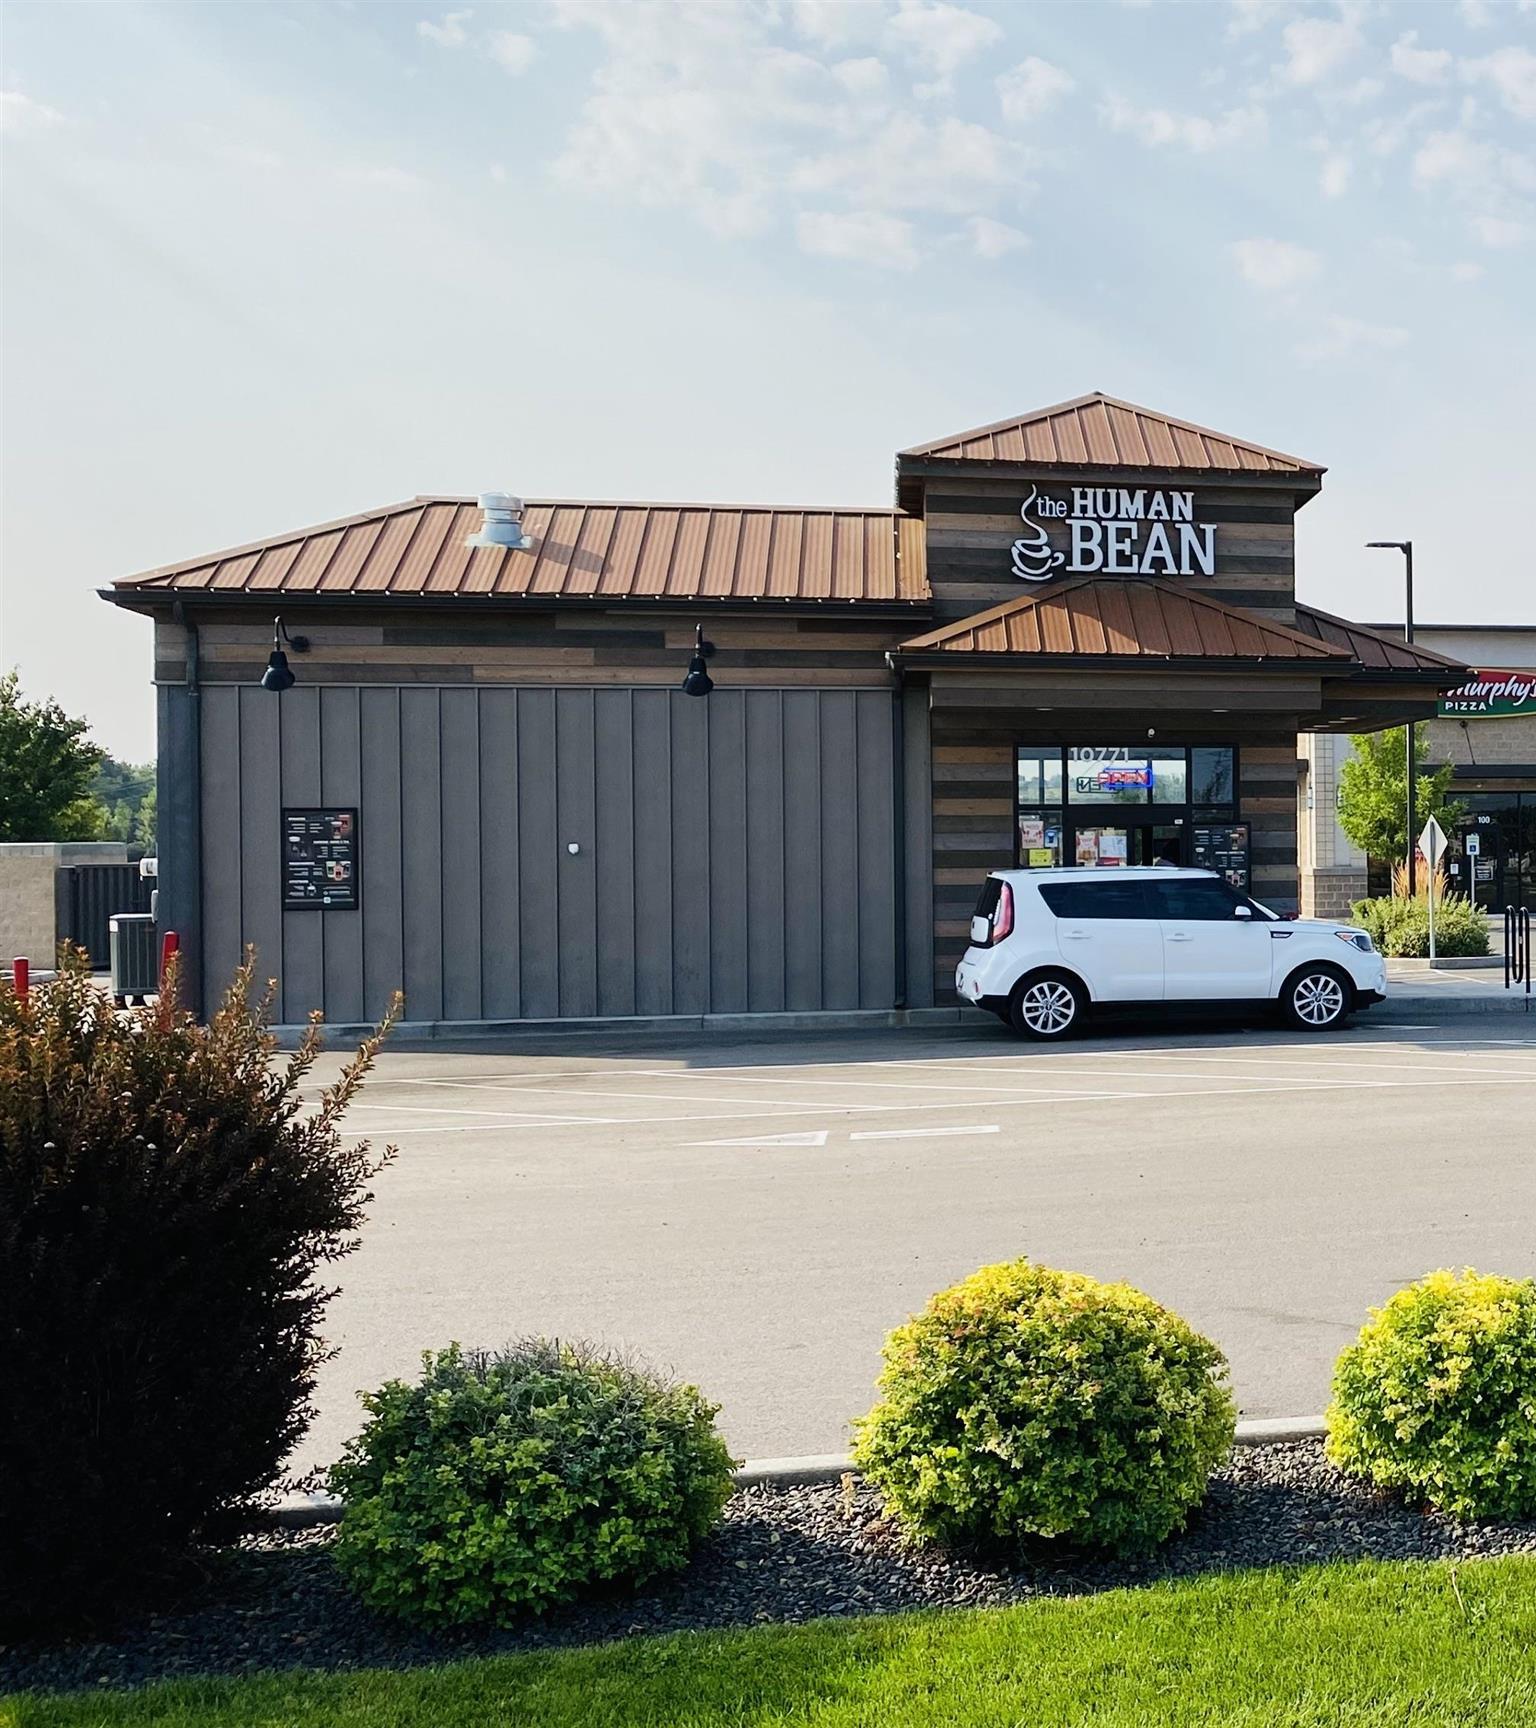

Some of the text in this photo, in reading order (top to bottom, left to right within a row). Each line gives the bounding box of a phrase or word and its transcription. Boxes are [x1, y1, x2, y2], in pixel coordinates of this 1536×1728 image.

[1036, 487, 1194, 521] the HUMAN
[1065, 519, 1218, 576] BEAN
[1445, 701, 1487, 711] PIZZA
[1070, 747, 1129, 763] 10771
